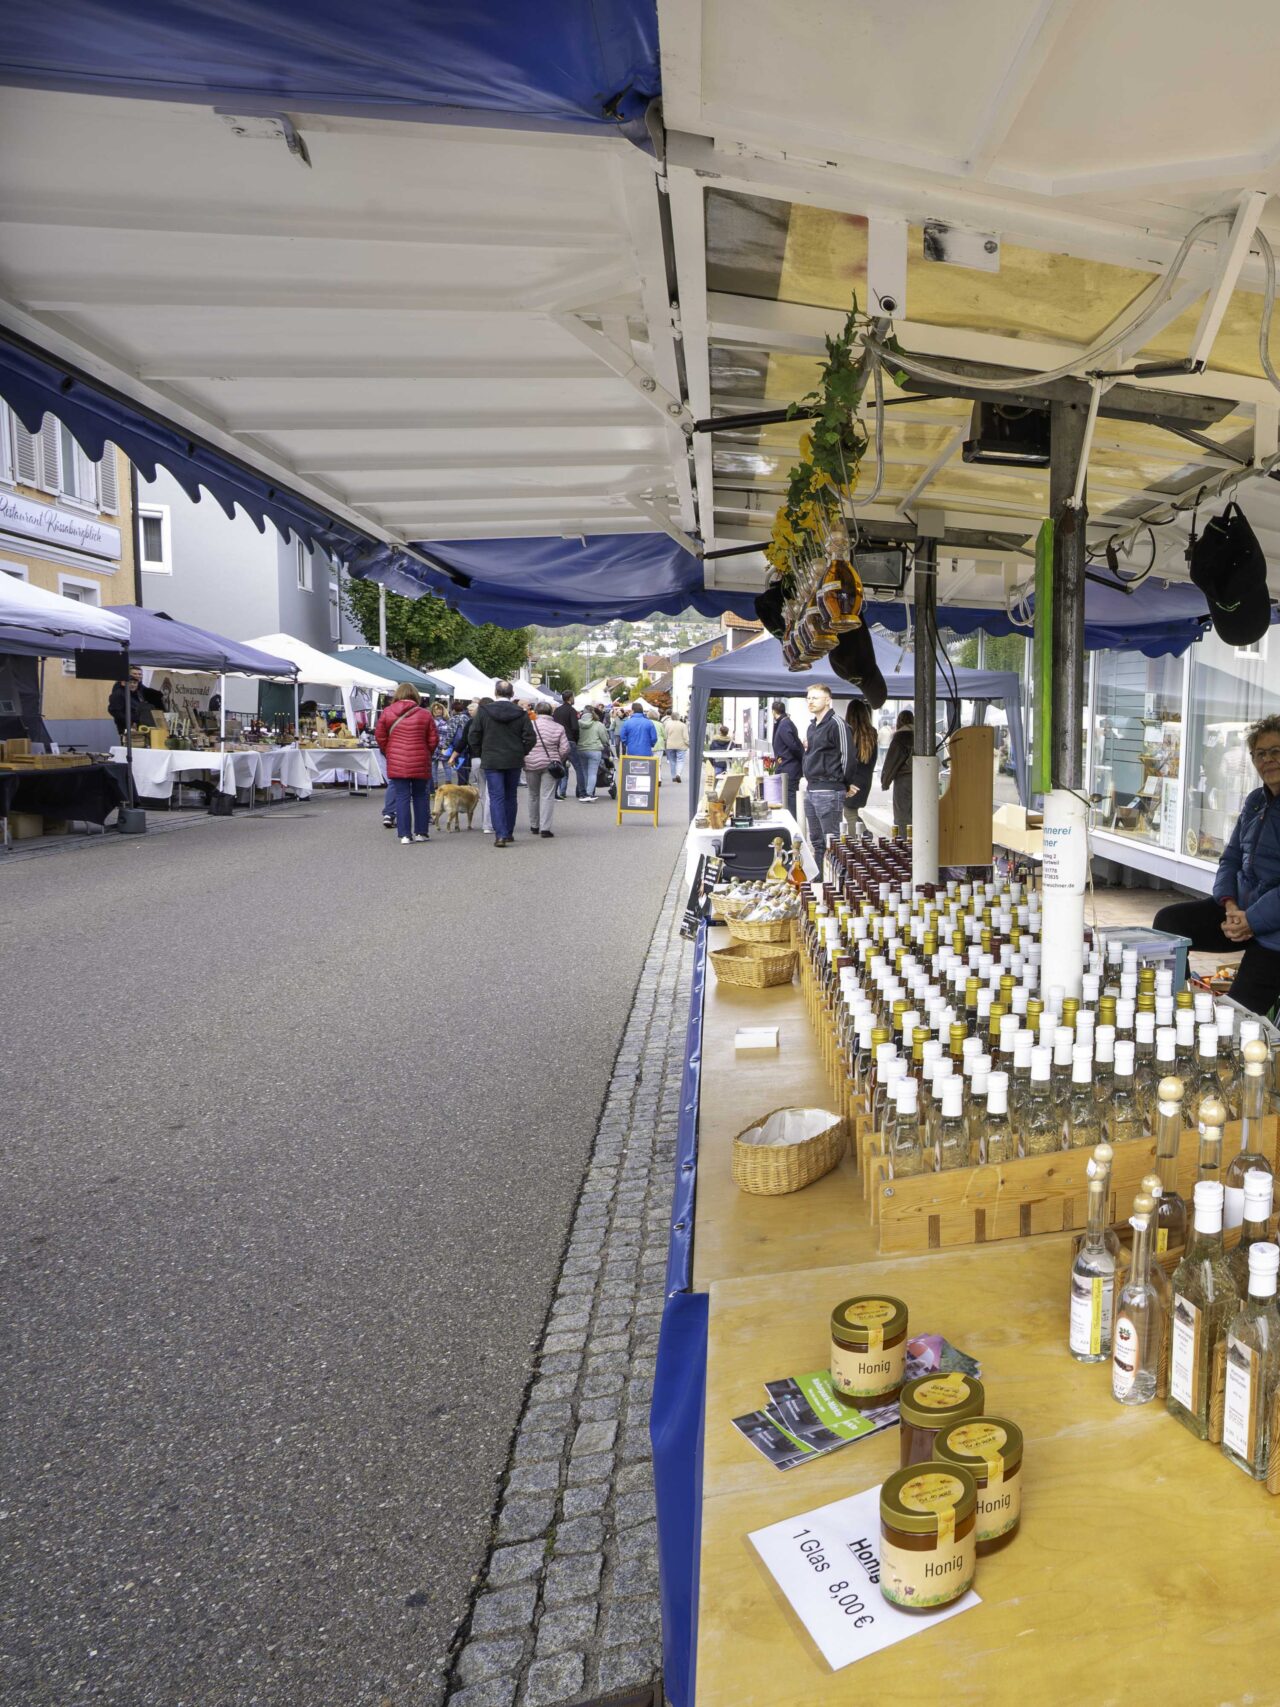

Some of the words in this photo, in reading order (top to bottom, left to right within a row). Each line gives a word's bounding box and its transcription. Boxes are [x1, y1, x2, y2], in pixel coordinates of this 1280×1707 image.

[858, 1360, 891, 1375] Honig
[976, 1492, 1012, 1515] Honig
[792, 1528, 810, 1540] 1
[799, 1538, 830, 1573] Glas
[925, 1555, 963, 1578] Honig
[828, 1580, 864, 1616] 8,00
[854, 1613, 874, 1630] €
